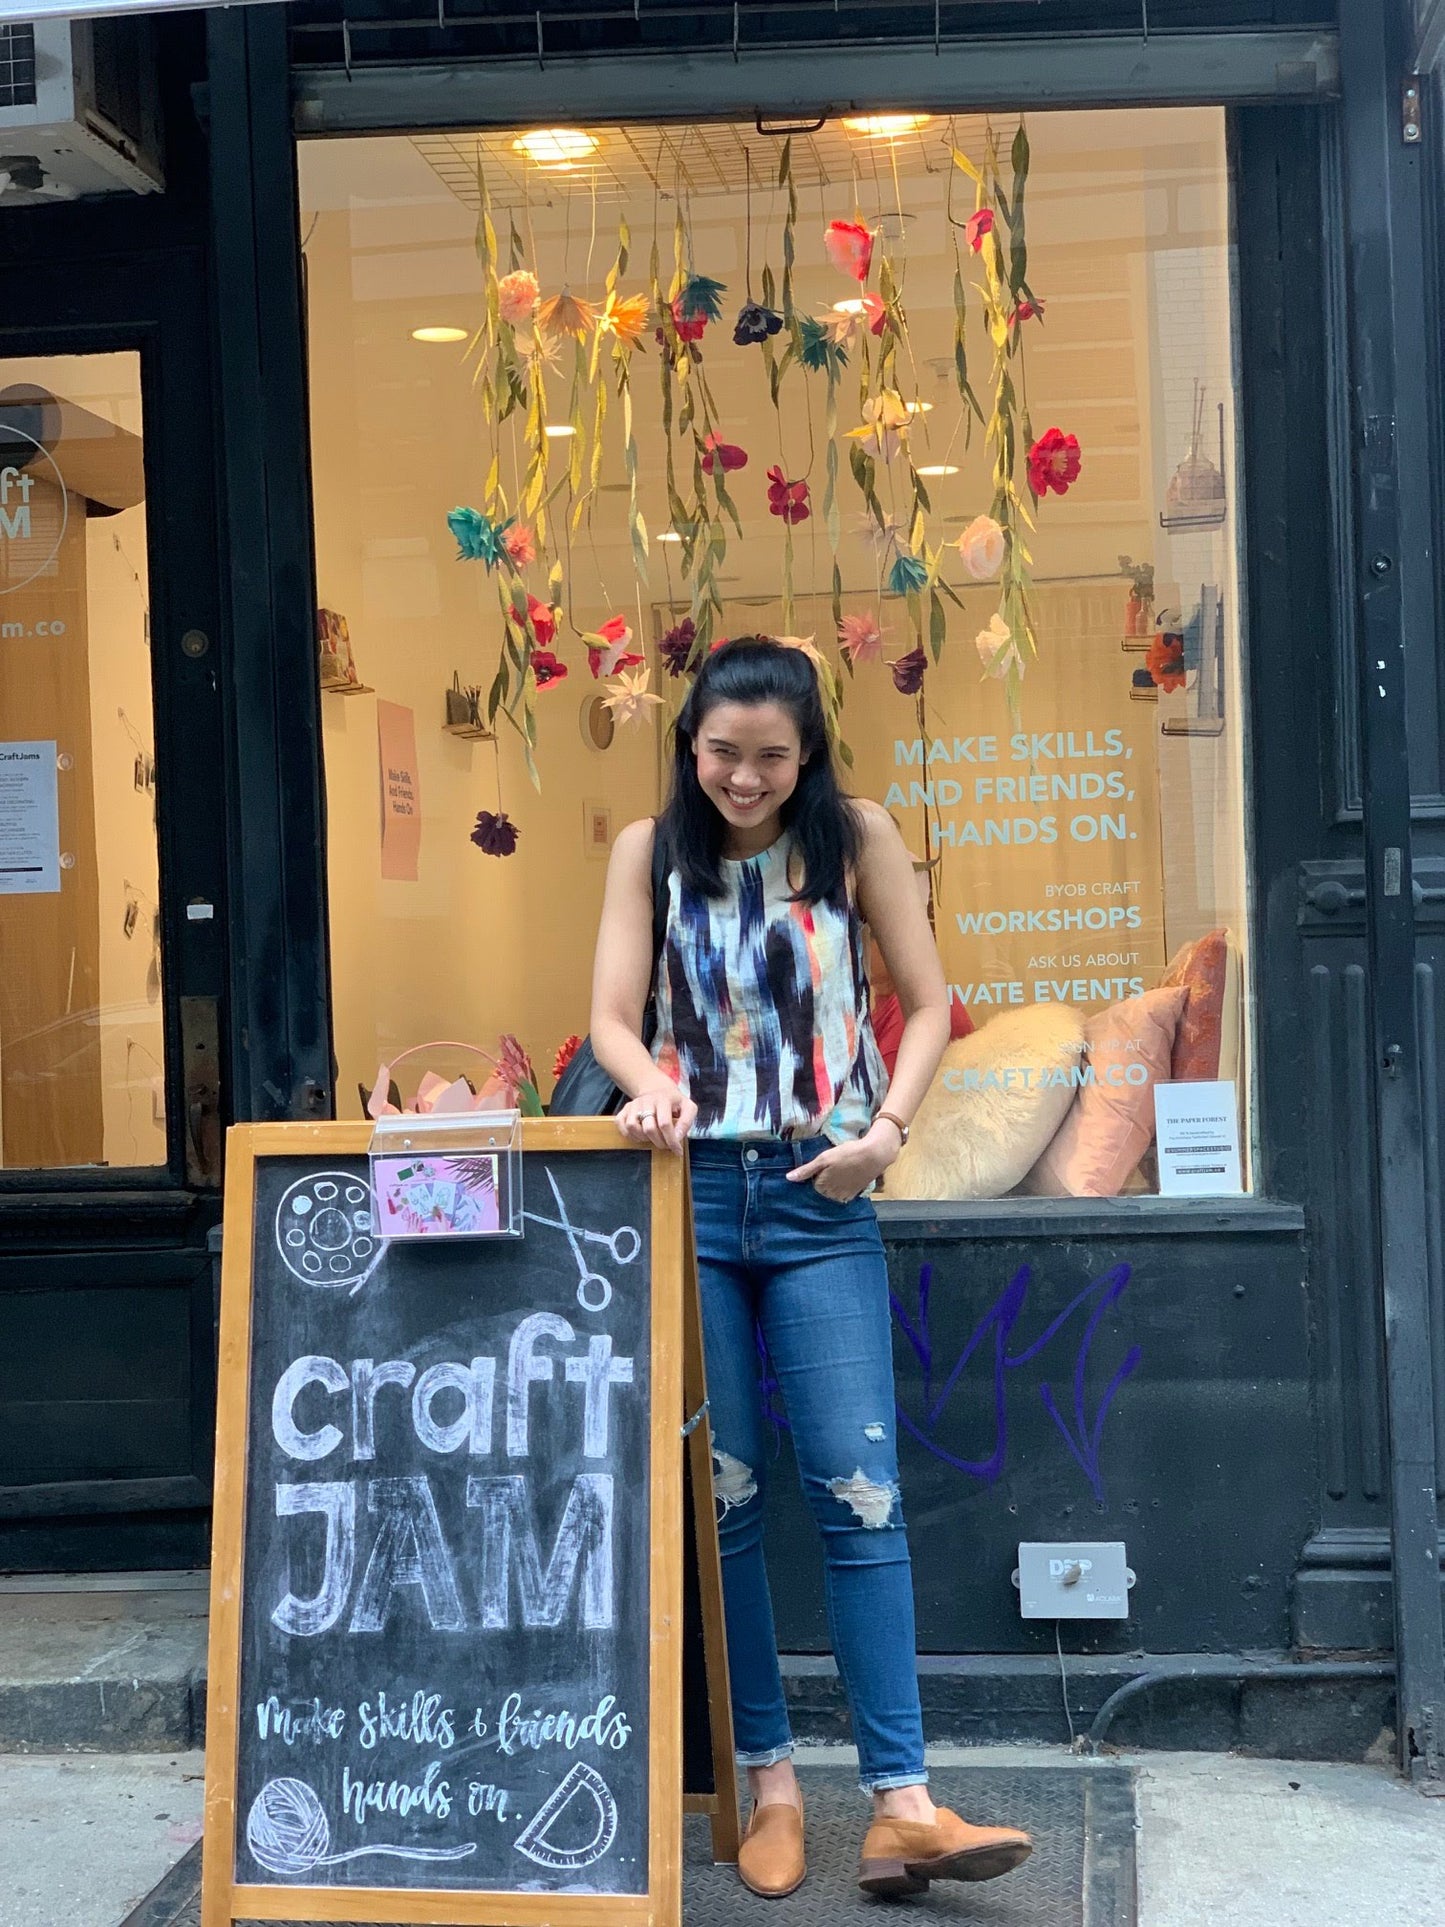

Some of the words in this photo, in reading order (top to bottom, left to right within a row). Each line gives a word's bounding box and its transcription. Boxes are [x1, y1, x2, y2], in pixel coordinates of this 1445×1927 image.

[0, 466, 35, 505] ft
[0, 505, 31, 539] M
[1, 620, 66, 638] m.co
[894, 736, 998, 766] MAKE
[1010, 729, 1133, 760] SKILLS,
[884, 780, 962, 809] AND
[975, 771, 1136, 803] FRIENDS,
[932, 816, 1058, 847] HANDS
[1070, 814, 1138, 842] ON.
[1045, 883, 1086, 897] BYOB
[1091, 881, 1141, 896] CRAFT
[956, 905, 1142, 934] WORKSHOPS
[1027, 955, 1058, 968] ASK
[1061, 955, 1081, 967] US
[1085, 952, 1140, 966] ABOUT
[946, 982, 1025, 1006] IVATE
[1034, 977, 1145, 1003] EVENTS
[1124, 1039, 1143, 1052] AT
[272, 1311, 633, 1460] craft
[271, 1473, 614, 1636] JAM
[359, 1689, 455, 1750] skills
[496, 1692, 632, 1756] friends
[343, 1760, 453, 1824] hands
